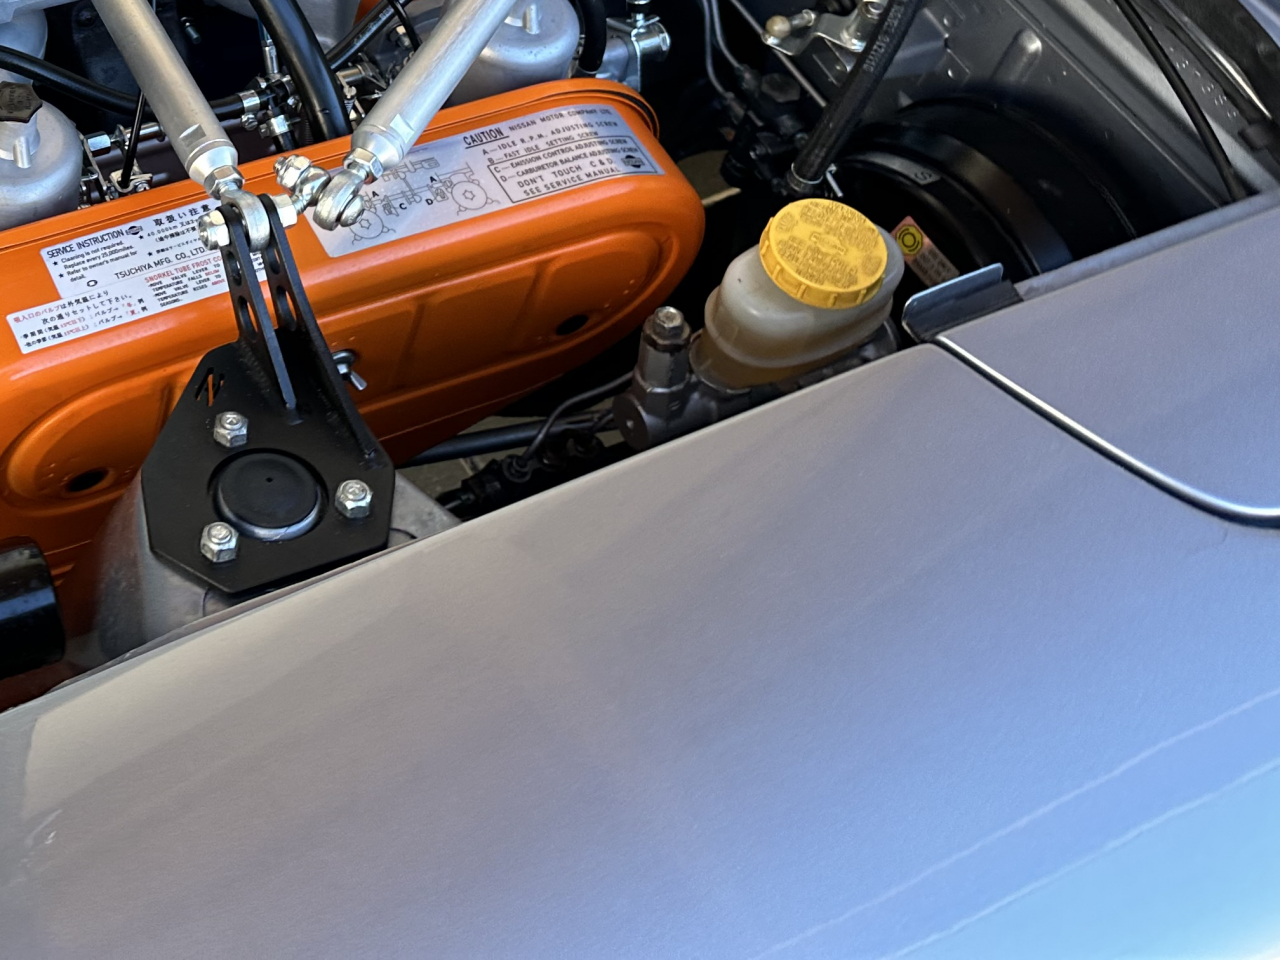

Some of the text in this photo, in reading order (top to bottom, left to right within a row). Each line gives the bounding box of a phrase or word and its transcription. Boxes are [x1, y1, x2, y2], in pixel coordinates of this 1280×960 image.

[463, 128, 504, 145] CAUTION
[509, 120, 536, 131] NISSAN
[540, 113, 563, 122] MOTOR
[567, 109, 597, 117] COMPANY
[551, 122, 594, 135] ADJUSTING
[524, 145, 540, 153] IDLE
[546, 136, 574, 146] SETTING
[543, 147, 574, 159] CONTROL
[575, 140, 608, 149] ADJUSTING
[609, 135, 627, 144] SCREW
[559, 153, 588, 164] BALANCE
[590, 148, 620, 156] ADJUSTING
[621, 143, 638, 153] SCREW
[517, 175, 544, 188] DON'T
[553, 165, 582, 177] TOUCH
[524, 187, 541, 196] SEE
[544, 175, 583, 190] SERVICE
[399, 202, 407, 210] C
[425, 198, 434, 206] D
[47, 244, 75, 258] SERVICE
[76, 229, 124, 249] INSTRUCTION
[61, 254, 85, 263] Cleaning
[101, 241, 123, 250] required.
[64, 261, 85, 269] Replace
[89, 260, 109, 269] owner's
[110, 254, 127, 262] manual
[115, 263, 153, 279] TSUCHIYA
[153, 257, 171, 267] MFG.
[145, 271, 174, 282] SNORKEL
[175, 265, 190, 273] TUBE
[192, 259, 211, 268] FROST
[156, 280, 182, 291] TEMPERATURE
[160, 290, 188, 301] TEMPERATURE
